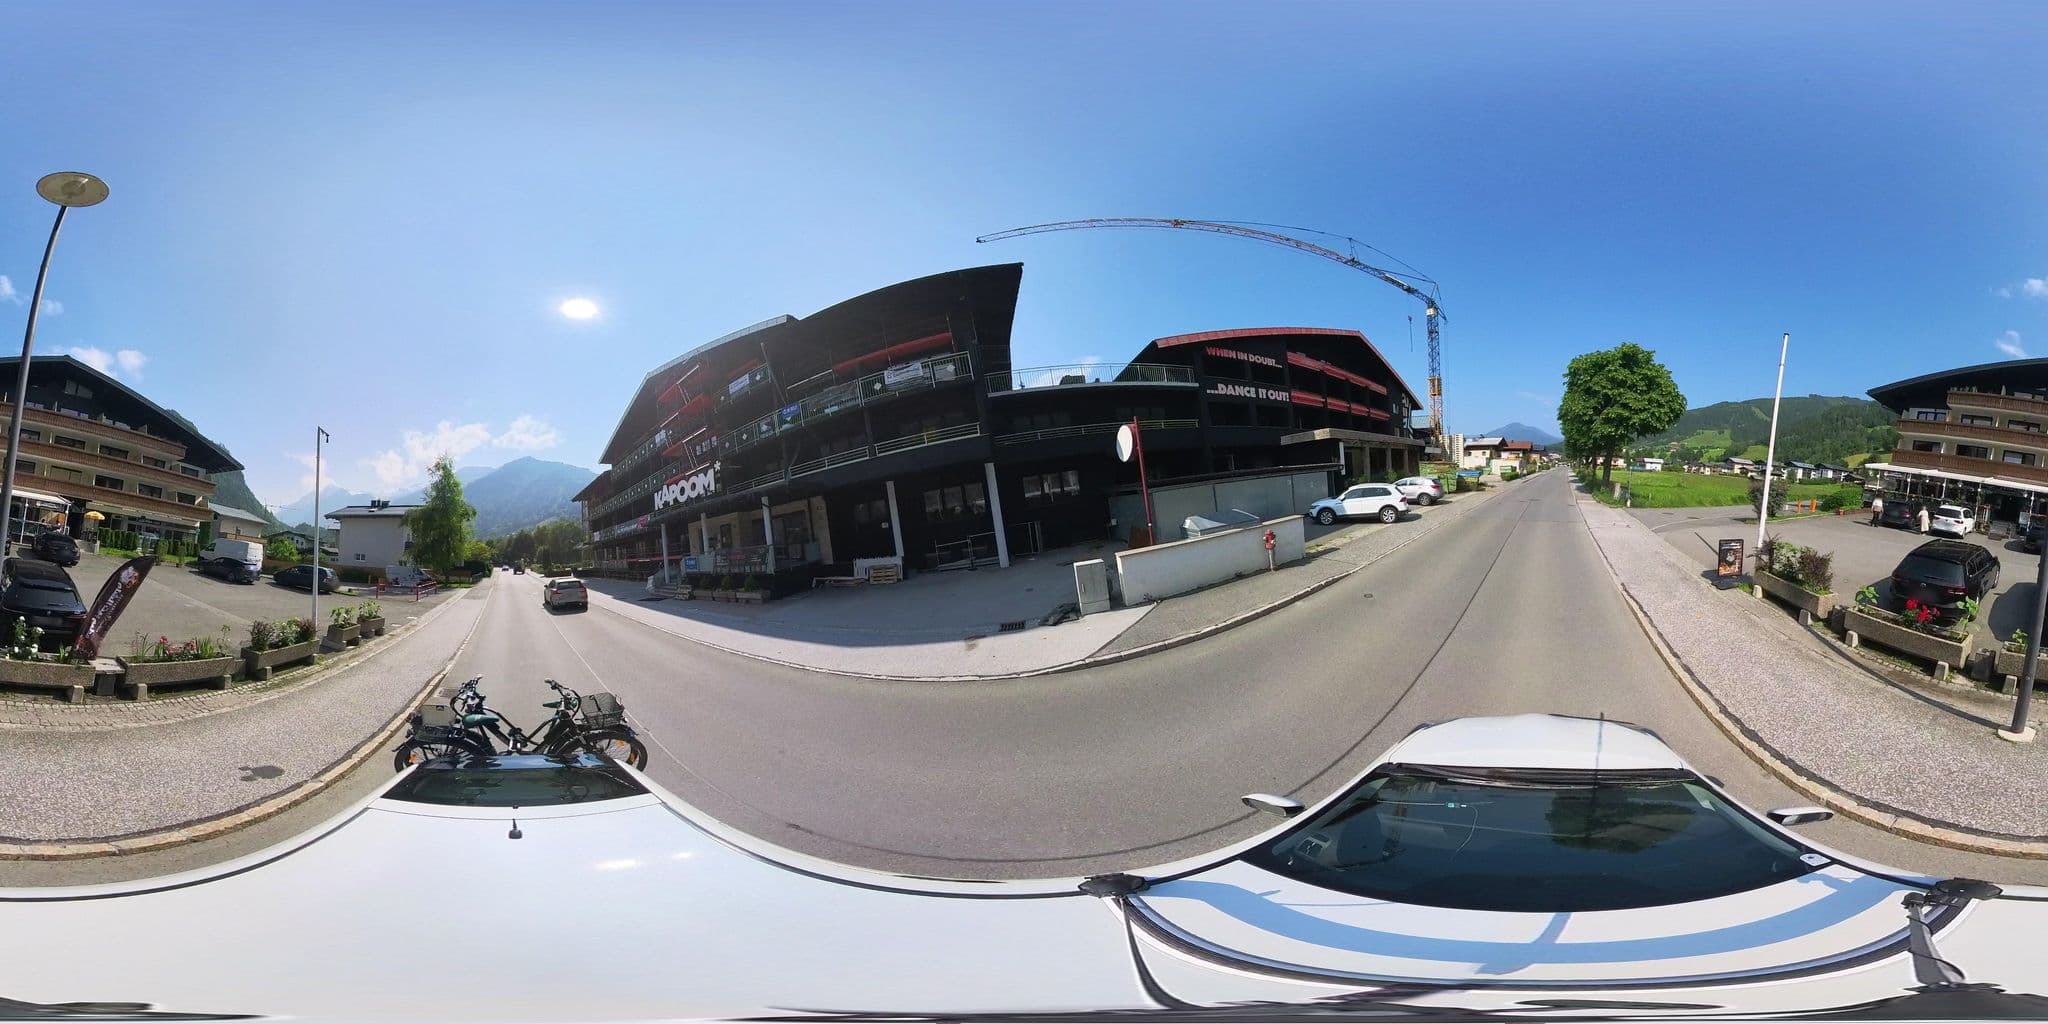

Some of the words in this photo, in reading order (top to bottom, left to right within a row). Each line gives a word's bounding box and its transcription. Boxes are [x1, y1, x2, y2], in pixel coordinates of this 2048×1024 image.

[1206, 347, 1236, 359] WHEN
[1237, 351, 1248, 361] IN
[1258, 387, 1267, 399] IT
[1267, 389, 1290, 402] OUT!
